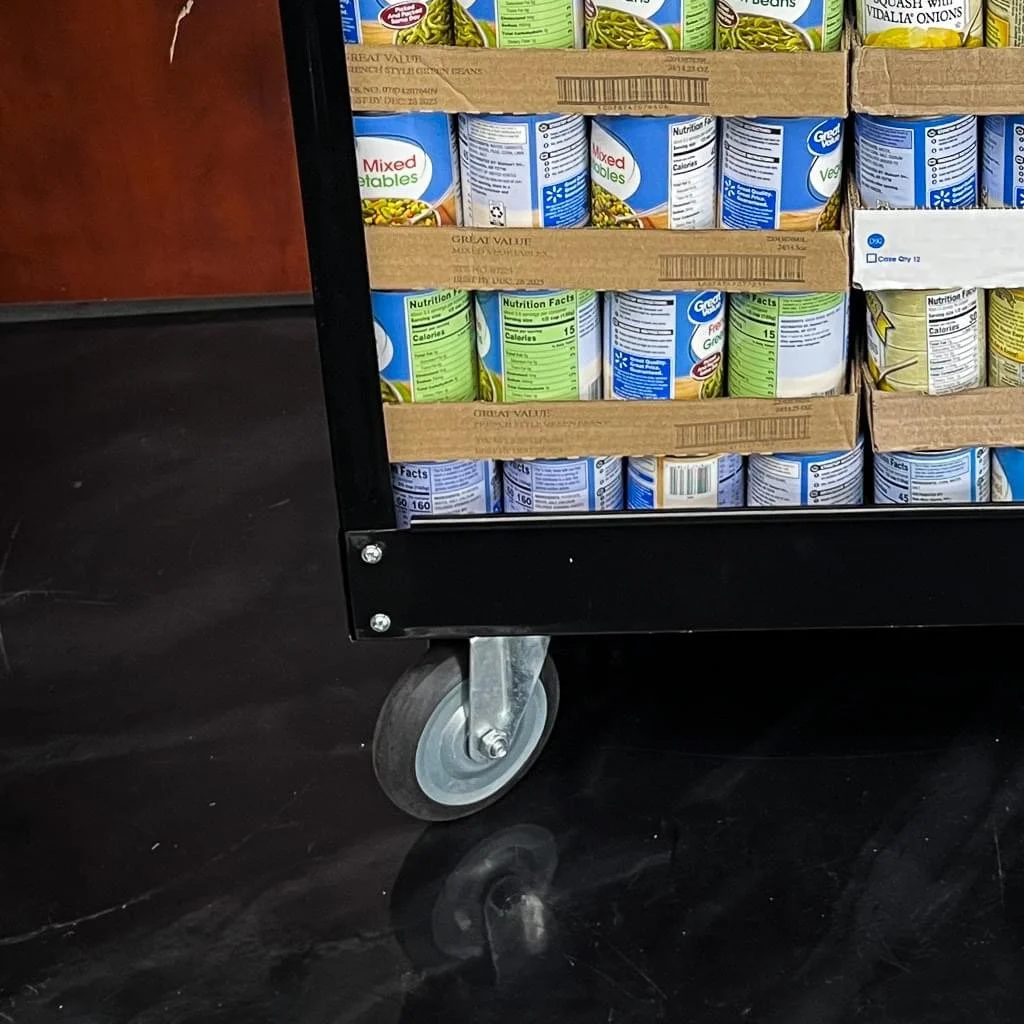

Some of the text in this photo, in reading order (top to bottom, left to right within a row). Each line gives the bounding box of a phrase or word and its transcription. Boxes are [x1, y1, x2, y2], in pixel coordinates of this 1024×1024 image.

[916, 6, 963, 24] ONIONS
[673, 122, 704, 136] Nutrition
[813, 125, 841, 143] Great
[362, 154, 417, 174] Mixed
[672, 160, 698, 172] Calories
[358, 172, 418, 189] etables
[898, 255, 911, 264] Qty
[913, 255, 921, 263] 12
[409, 292, 451, 309] Nutrition
[503, 293, 575, 308] Nutrition Facts
[694, 294, 721, 311] Great
[927, 292, 961, 306] Nutrition
[412, 329, 445, 342] Calories
[505, 326, 575, 342] Calories 15
[763, 329, 776, 339] 15
[929, 324, 960, 335] Calories
[400, 463, 428, 480] Facts
[890, 459, 908, 472] Facts
[898, 493, 908, 503] 45
